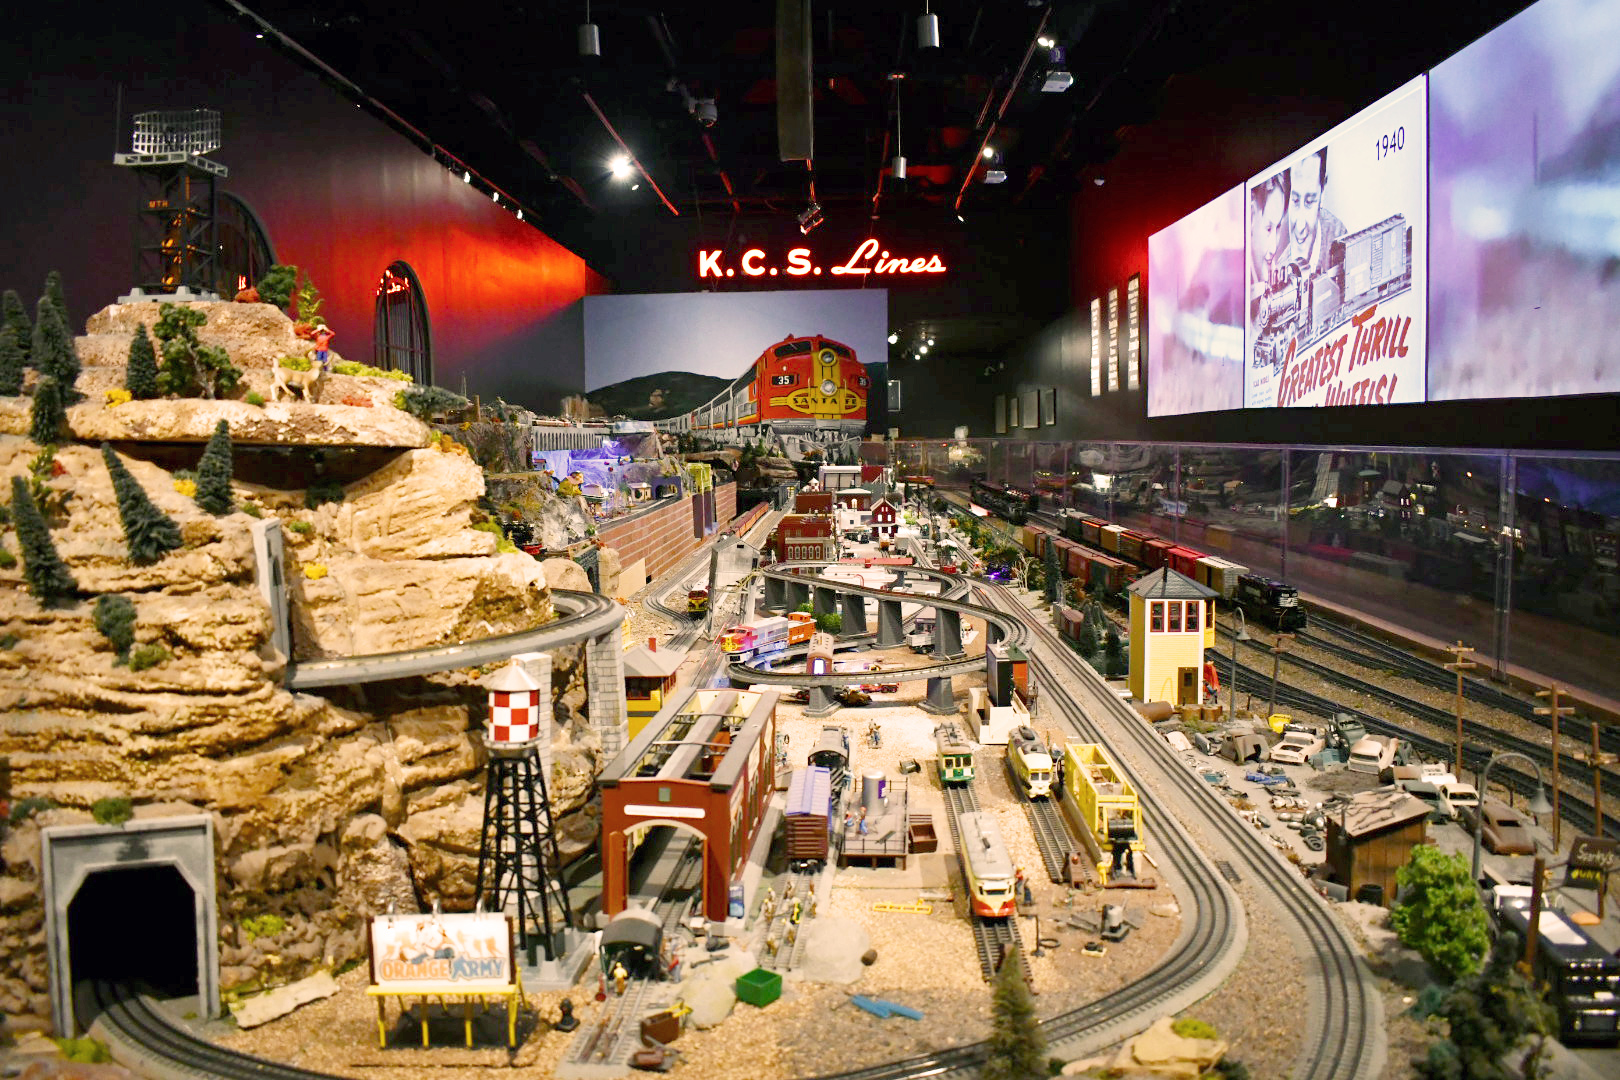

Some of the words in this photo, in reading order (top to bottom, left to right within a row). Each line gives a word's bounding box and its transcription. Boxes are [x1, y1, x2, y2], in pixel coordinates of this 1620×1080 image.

[1376, 126, 1405, 161] 1940
[830, 238, 948, 275] Lines
[1277, 333, 1349, 408] GREATEST
[1348, 303, 1412, 374] THRILL
[778, 375, 790, 385] 35
[793, 397, 838, 405] SANTA
[382, 959, 449, 979] ORANGE
[451, 955, 505, 980] ARMY
